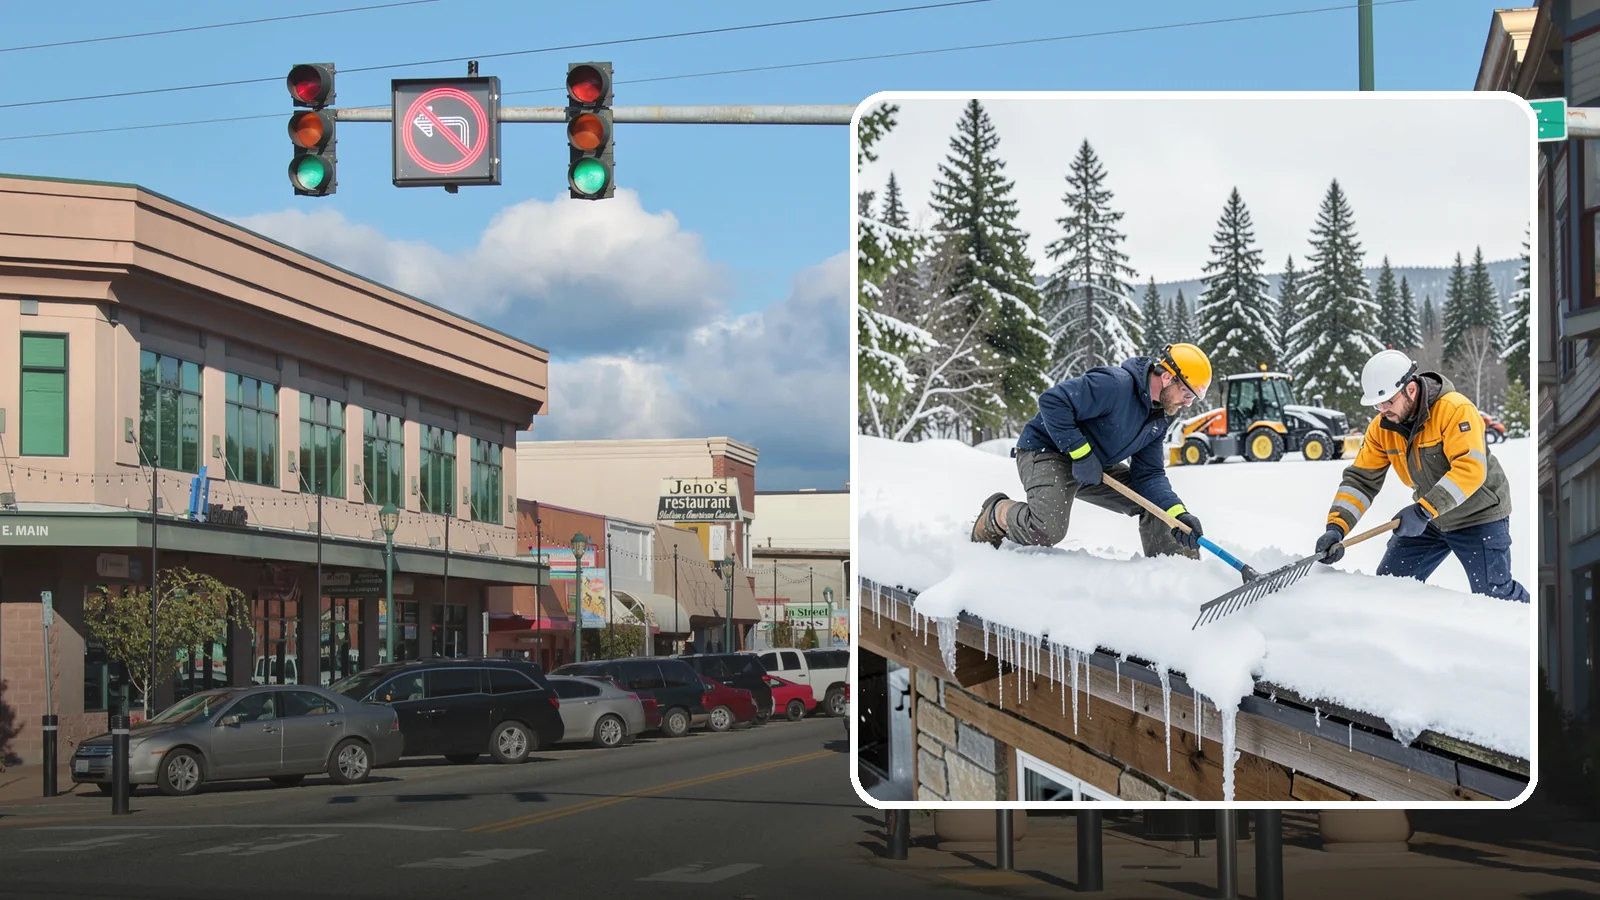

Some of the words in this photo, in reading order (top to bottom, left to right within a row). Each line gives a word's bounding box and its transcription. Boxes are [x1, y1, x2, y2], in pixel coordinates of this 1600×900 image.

[669, 480, 727, 495] Jeno's
[665, 496, 731, 509] restaurant
[658, 509, 682, 519] Italian
[686, 509, 714, 519] American
[715, 509, 738, 519] Cuisine
[2, 525, 13, 536] E.
[15, 525, 49, 536] MAIN
[797, 607, 829, 616] Street
[791, 619, 823, 627] lass
